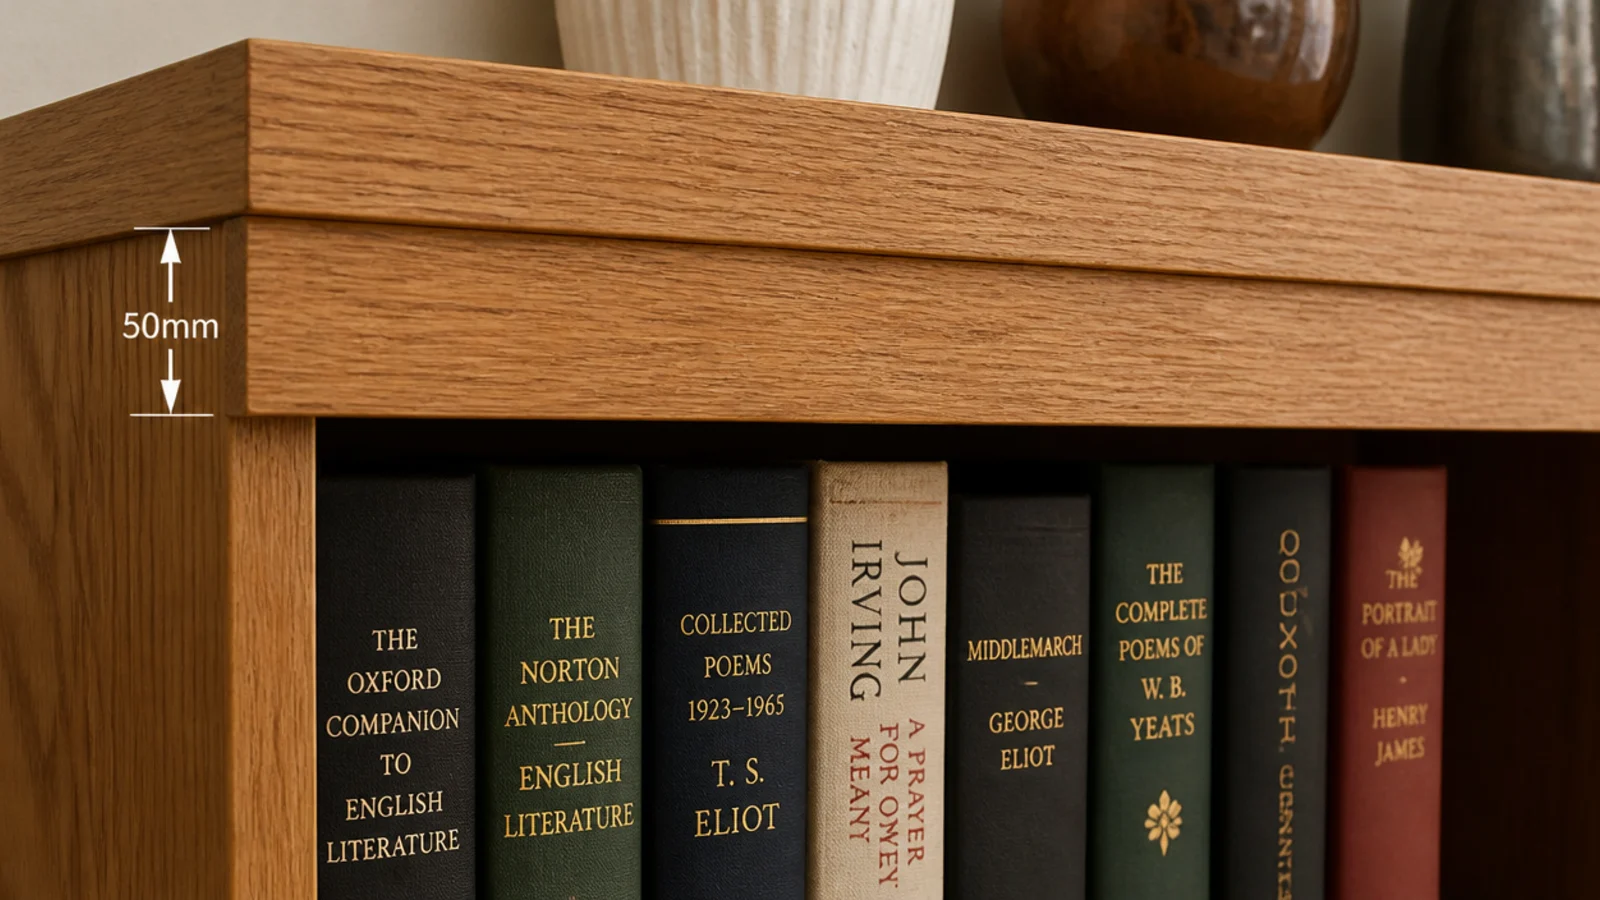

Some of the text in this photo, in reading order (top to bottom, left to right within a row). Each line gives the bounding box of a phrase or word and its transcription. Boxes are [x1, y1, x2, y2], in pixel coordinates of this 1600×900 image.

[1146, 562, 1183, 585] THE
[1386, 569, 1419, 589] THE
[680, 609, 792, 636] COLLECTED
[849, 540, 883, 701] IRVING
[894, 551, 929, 683] JOHN
[1115, 598, 1207, 624] COMPLETE
[1363, 600, 1437, 624] PORTRAIT
[372, 627, 418, 652] THE
[549, 616, 595, 640] THE
[967, 634, 1083, 661] MIDDLEMARCH
[1119, 635, 1204, 661] POEMS OF
[1361, 635, 1438, 659] OF A LADY
[520, 656, 620, 685] NORTON
[704, 652, 772, 679] POEMS
[347, 667, 442, 694] OXFORD
[1141, 675, 1187, 700] W. B.
[326, 707, 460, 738] COMPANION
[504, 697, 633, 727] ANTHOLOGY
[989, 706, 1064, 734] GEORGE
[1130, 711, 1195, 741] YEATS
[1373, 704, 1427, 728] HENRY
[379, 752, 412, 776] TO
[879, 723, 899, 785] FOR
[1000, 744, 1056, 771] ELIOT
[1375, 736, 1425, 766] JAMES
[519, 758, 622, 791] ENGLISH
[711, 757, 764, 788] T. S.
[849, 737, 871, 843] MEANY
[907, 718, 926, 866] A PRAYER
[345, 790, 443, 821] ENGLISH
[694, 802, 780, 837] ELIOT
[504, 802, 634, 838] LITERATURE
[327, 828, 460, 863] LITERATURE
